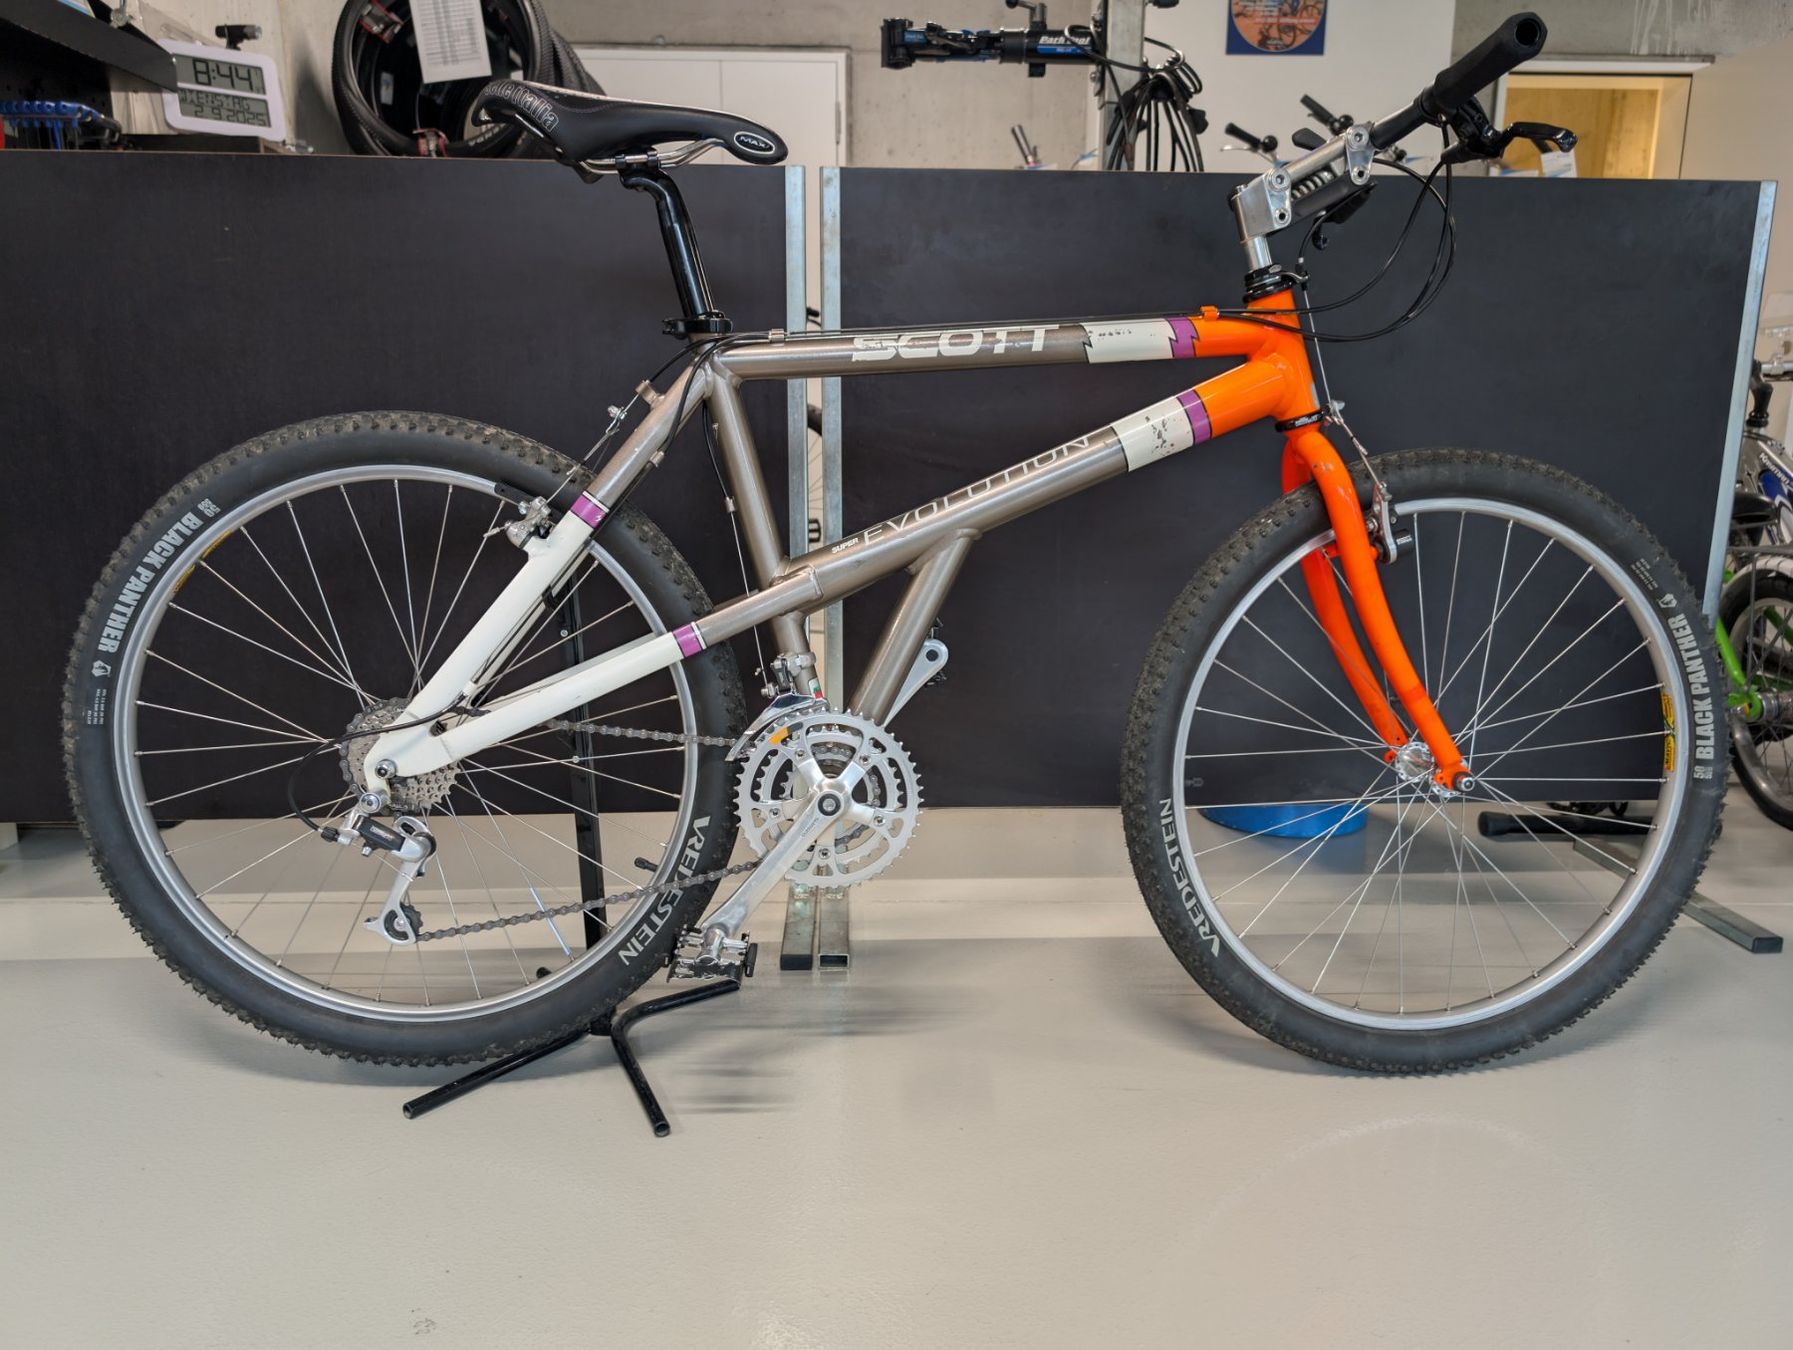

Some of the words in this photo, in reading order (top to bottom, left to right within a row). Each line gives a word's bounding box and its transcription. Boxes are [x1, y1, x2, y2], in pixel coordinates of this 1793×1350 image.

[192, 58, 254, 92] 8:44
[852, 325, 1060, 363] SCOTT
[831, 537, 859, 554] SUPER
[863, 434, 1090, 546] EVOLUTION
[142, 511, 205, 570] BLACK
[98, 565, 156, 654] PANTHER
[1667, 612, 1712, 695] PANTHER
[1692, 696, 1715, 760] BLACK
[1159, 798, 1221, 958] VREDESTEIN
